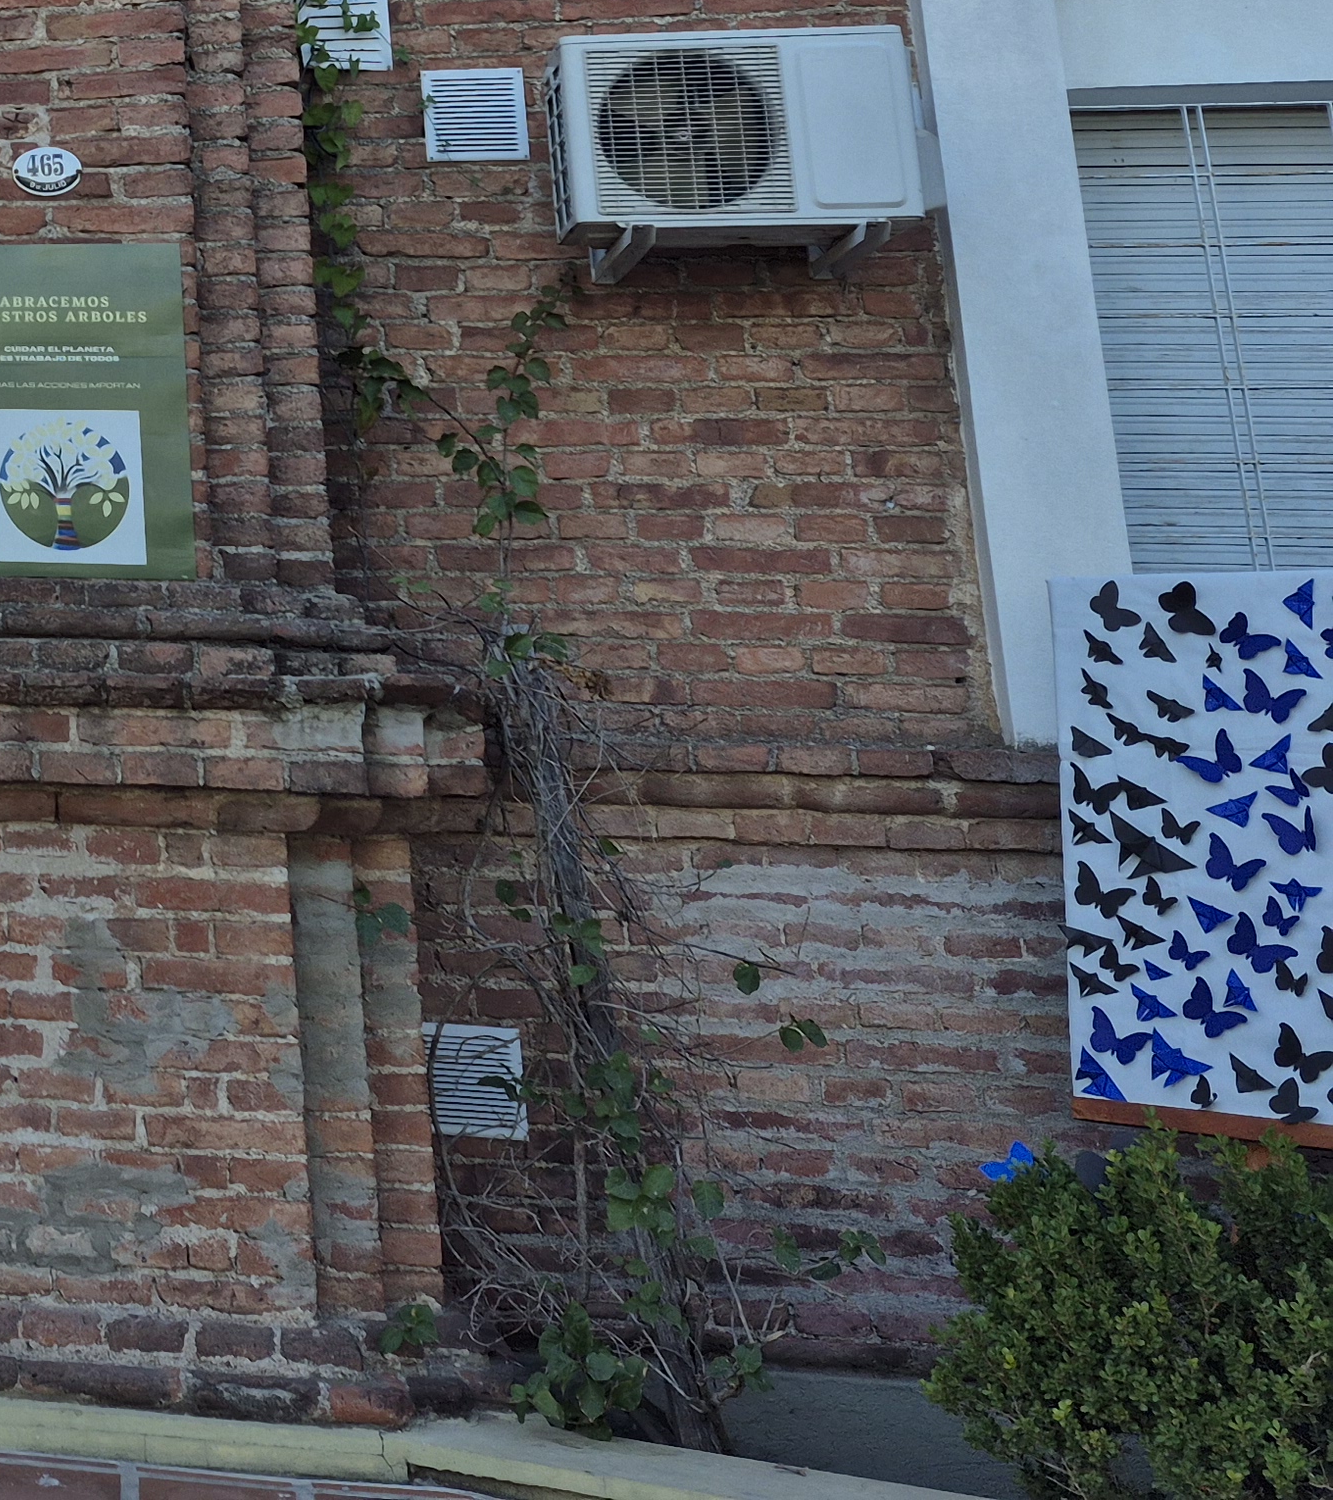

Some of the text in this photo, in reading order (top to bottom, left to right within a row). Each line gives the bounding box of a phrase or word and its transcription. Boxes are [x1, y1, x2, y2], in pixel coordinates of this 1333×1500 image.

[27, 153, 64, 177] 465
[42, 180, 67, 191] JULIO
[0, 296, 109, 308] ABRACEMOS
[65, 310, 148, 323] ARBOLES
[4, 345, 115, 353] CUIDAR EL PLANETA
